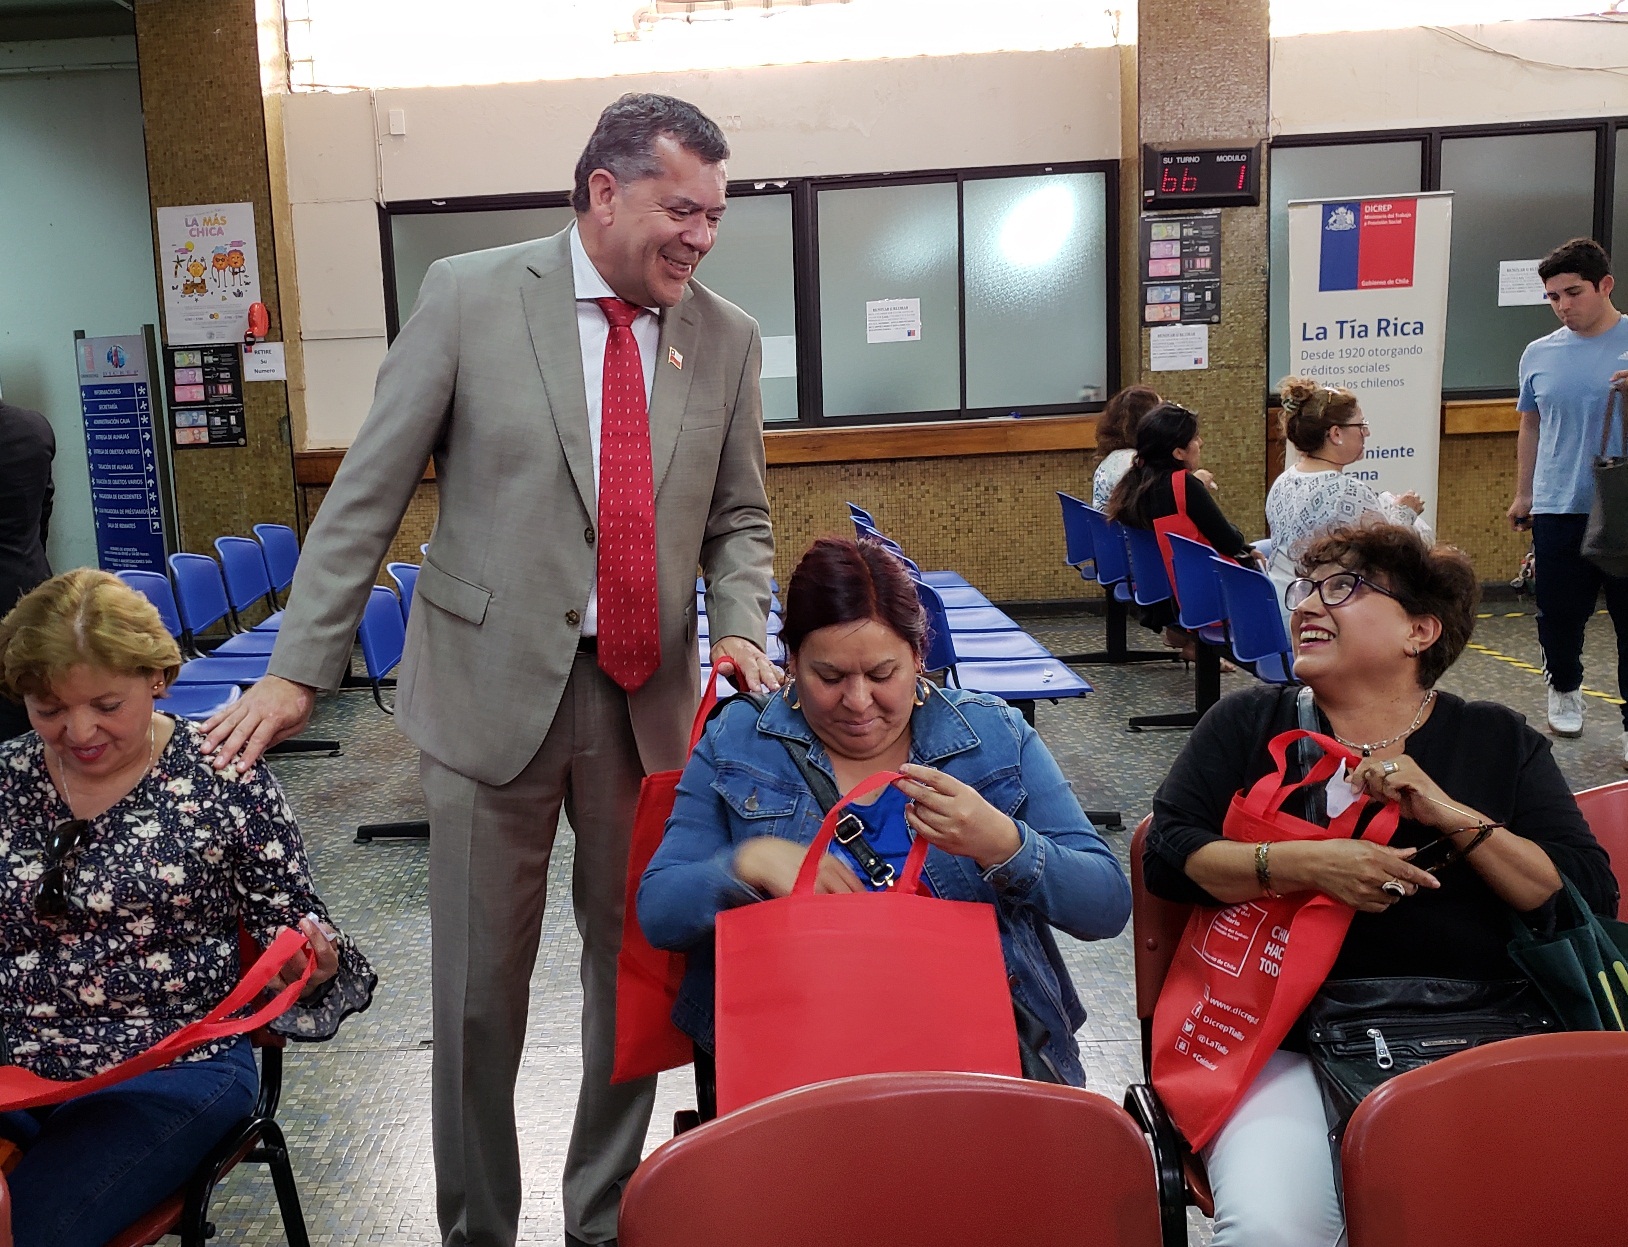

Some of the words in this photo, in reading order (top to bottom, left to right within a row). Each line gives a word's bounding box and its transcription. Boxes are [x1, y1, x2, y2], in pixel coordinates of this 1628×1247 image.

[1163, 156, 1173, 164] SU
[1216, 154, 1247, 162] MODULO
[1237, 165, 1247, 189] 1
[1364, 204, 1392, 213] DICREP
[184, 217, 199, 227] LA
[202, 213, 228, 226] MÁS
[189, 226, 224, 238] CHICA
[1302, 322, 1328, 341] La
[1335, 318, 1369, 340] Tía
[1376, 317, 1424, 338] Rica
[1301, 349, 1335, 361] Desde
[1339, 347, 1365, 359] 1920
[1368, 344, 1423, 359] otorgando
[1300, 364, 1345, 376] créditos
[1348, 362, 1390, 374] sociales
[1321, 380, 1340, 388] dos
[1343, 379, 1358, 389] los
[1360, 377, 1405, 389] chilenos
[1365, 446, 1415, 459] niente
[1264, 941, 1285, 961] HAC
[1259, 956, 1282, 977] TOD
[1209, 997, 1260, 1025] www.dicrep
